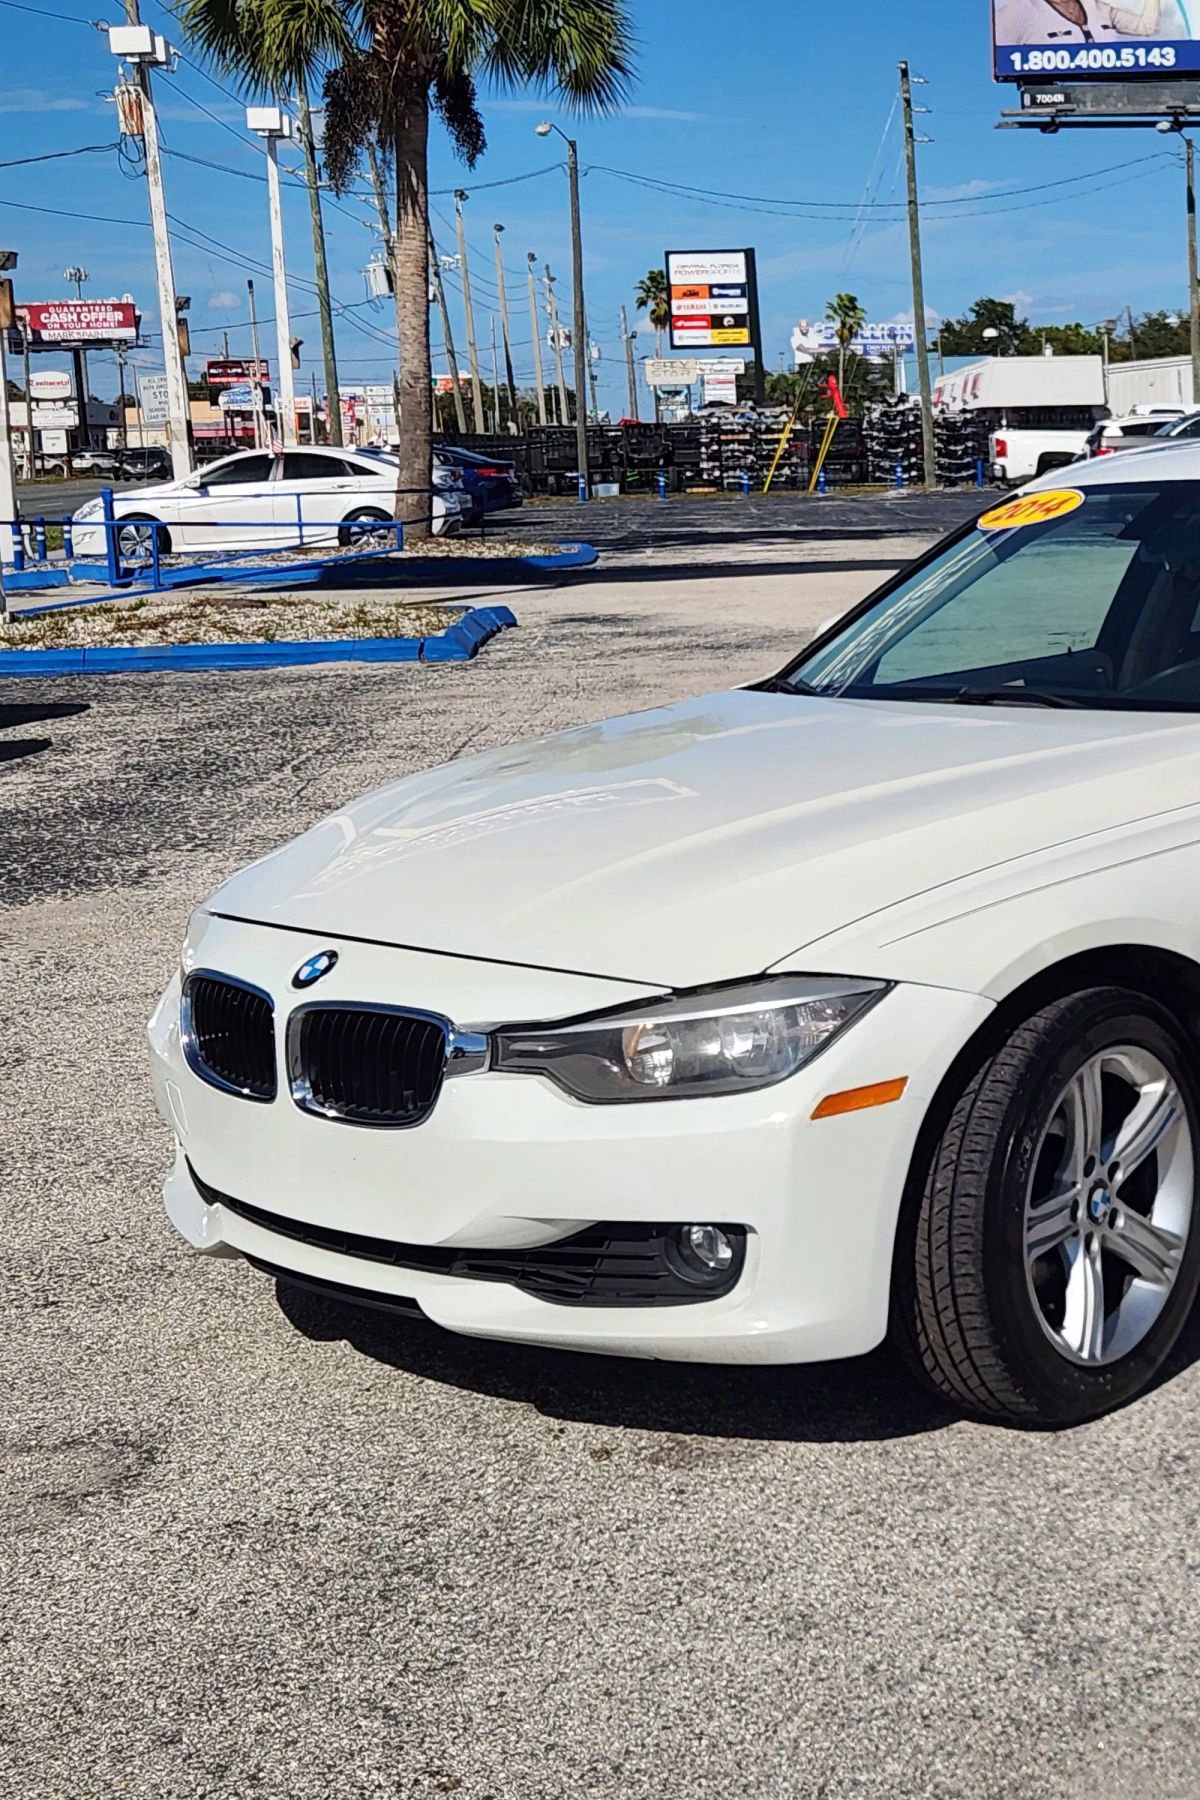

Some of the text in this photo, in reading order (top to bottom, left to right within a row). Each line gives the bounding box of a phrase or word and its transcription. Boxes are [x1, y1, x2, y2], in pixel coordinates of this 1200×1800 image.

[1009, 47, 1176, 71] 1.800.400.5143
[48, 305, 113, 313] GUARANTEED
[40, 311, 124, 323] CASH OFFER
[152, 390, 169, 400] STO
[986, 496, 1075, 522] 2014
